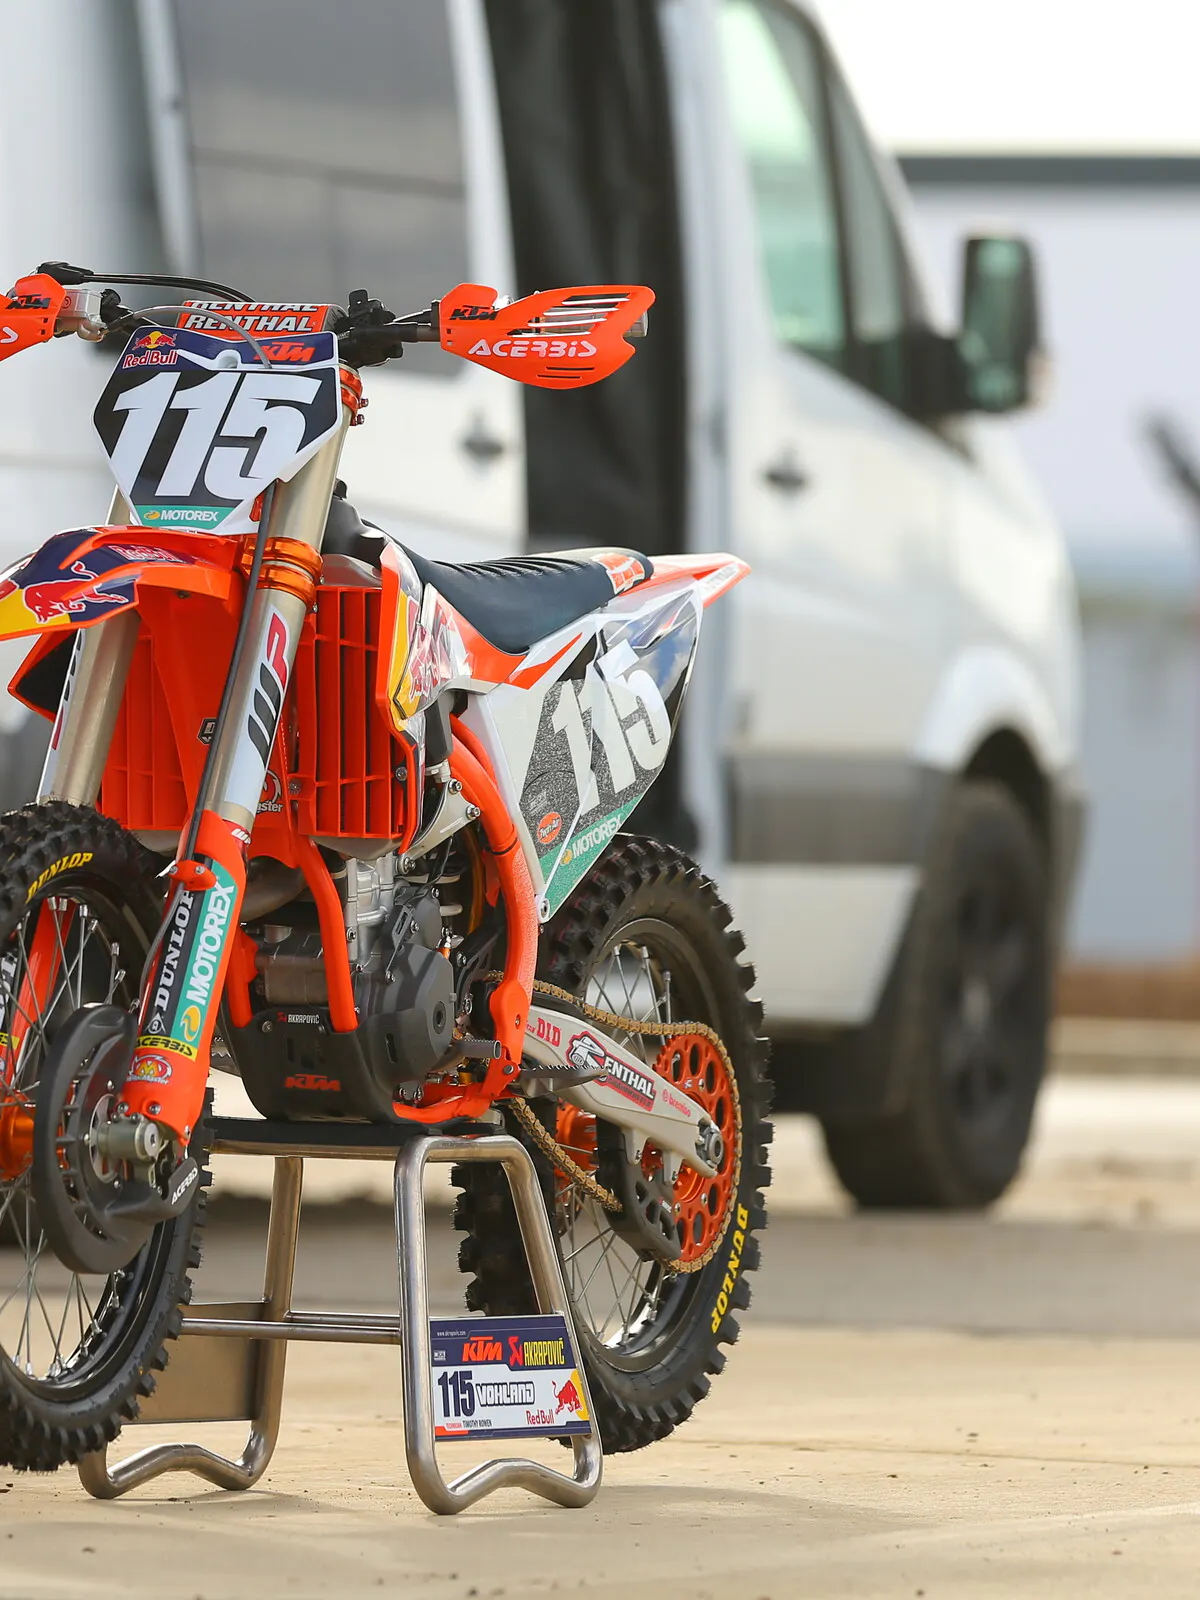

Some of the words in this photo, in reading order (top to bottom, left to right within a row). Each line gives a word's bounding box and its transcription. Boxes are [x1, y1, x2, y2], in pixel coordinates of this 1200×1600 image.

[5, 293, 51, 310] KTM
[449, 304, 499, 321] KTM
[184, 314, 313, 332] RENTHAL
[122, 352, 148, 369] Red
[149, 349, 178, 366] Bull
[253, 341, 316, 363] KTM
[468, 339, 597, 358] ACERBIS
[110, 371, 323, 500] 115
[160, 509, 220, 523] MOTOREX
[552, 638, 672, 816] 115
[571, 814, 623, 860] MOTOREX
[25, 852, 94, 904] DUNLOP
[154, 889, 194, 1011] DUNLOP
[186, 883, 235, 1006] MOTOREX
[136, 1034, 193, 1057] ACERBIS
[536, 1017, 562, 1048] DID
[284, 1073, 341, 1092] KTM
[171, 1166, 198, 1206] ACERBIS
[710, 1203, 749, 1334] DUNLOP
[462, 1336, 503, 1362] KTM
[437, 1370, 476, 1418] 115
[475, 1381, 536, 1407] VOHLAND
[526, 1409, 540, 1425] Red
[540, 1408, 555, 1424] Bull
